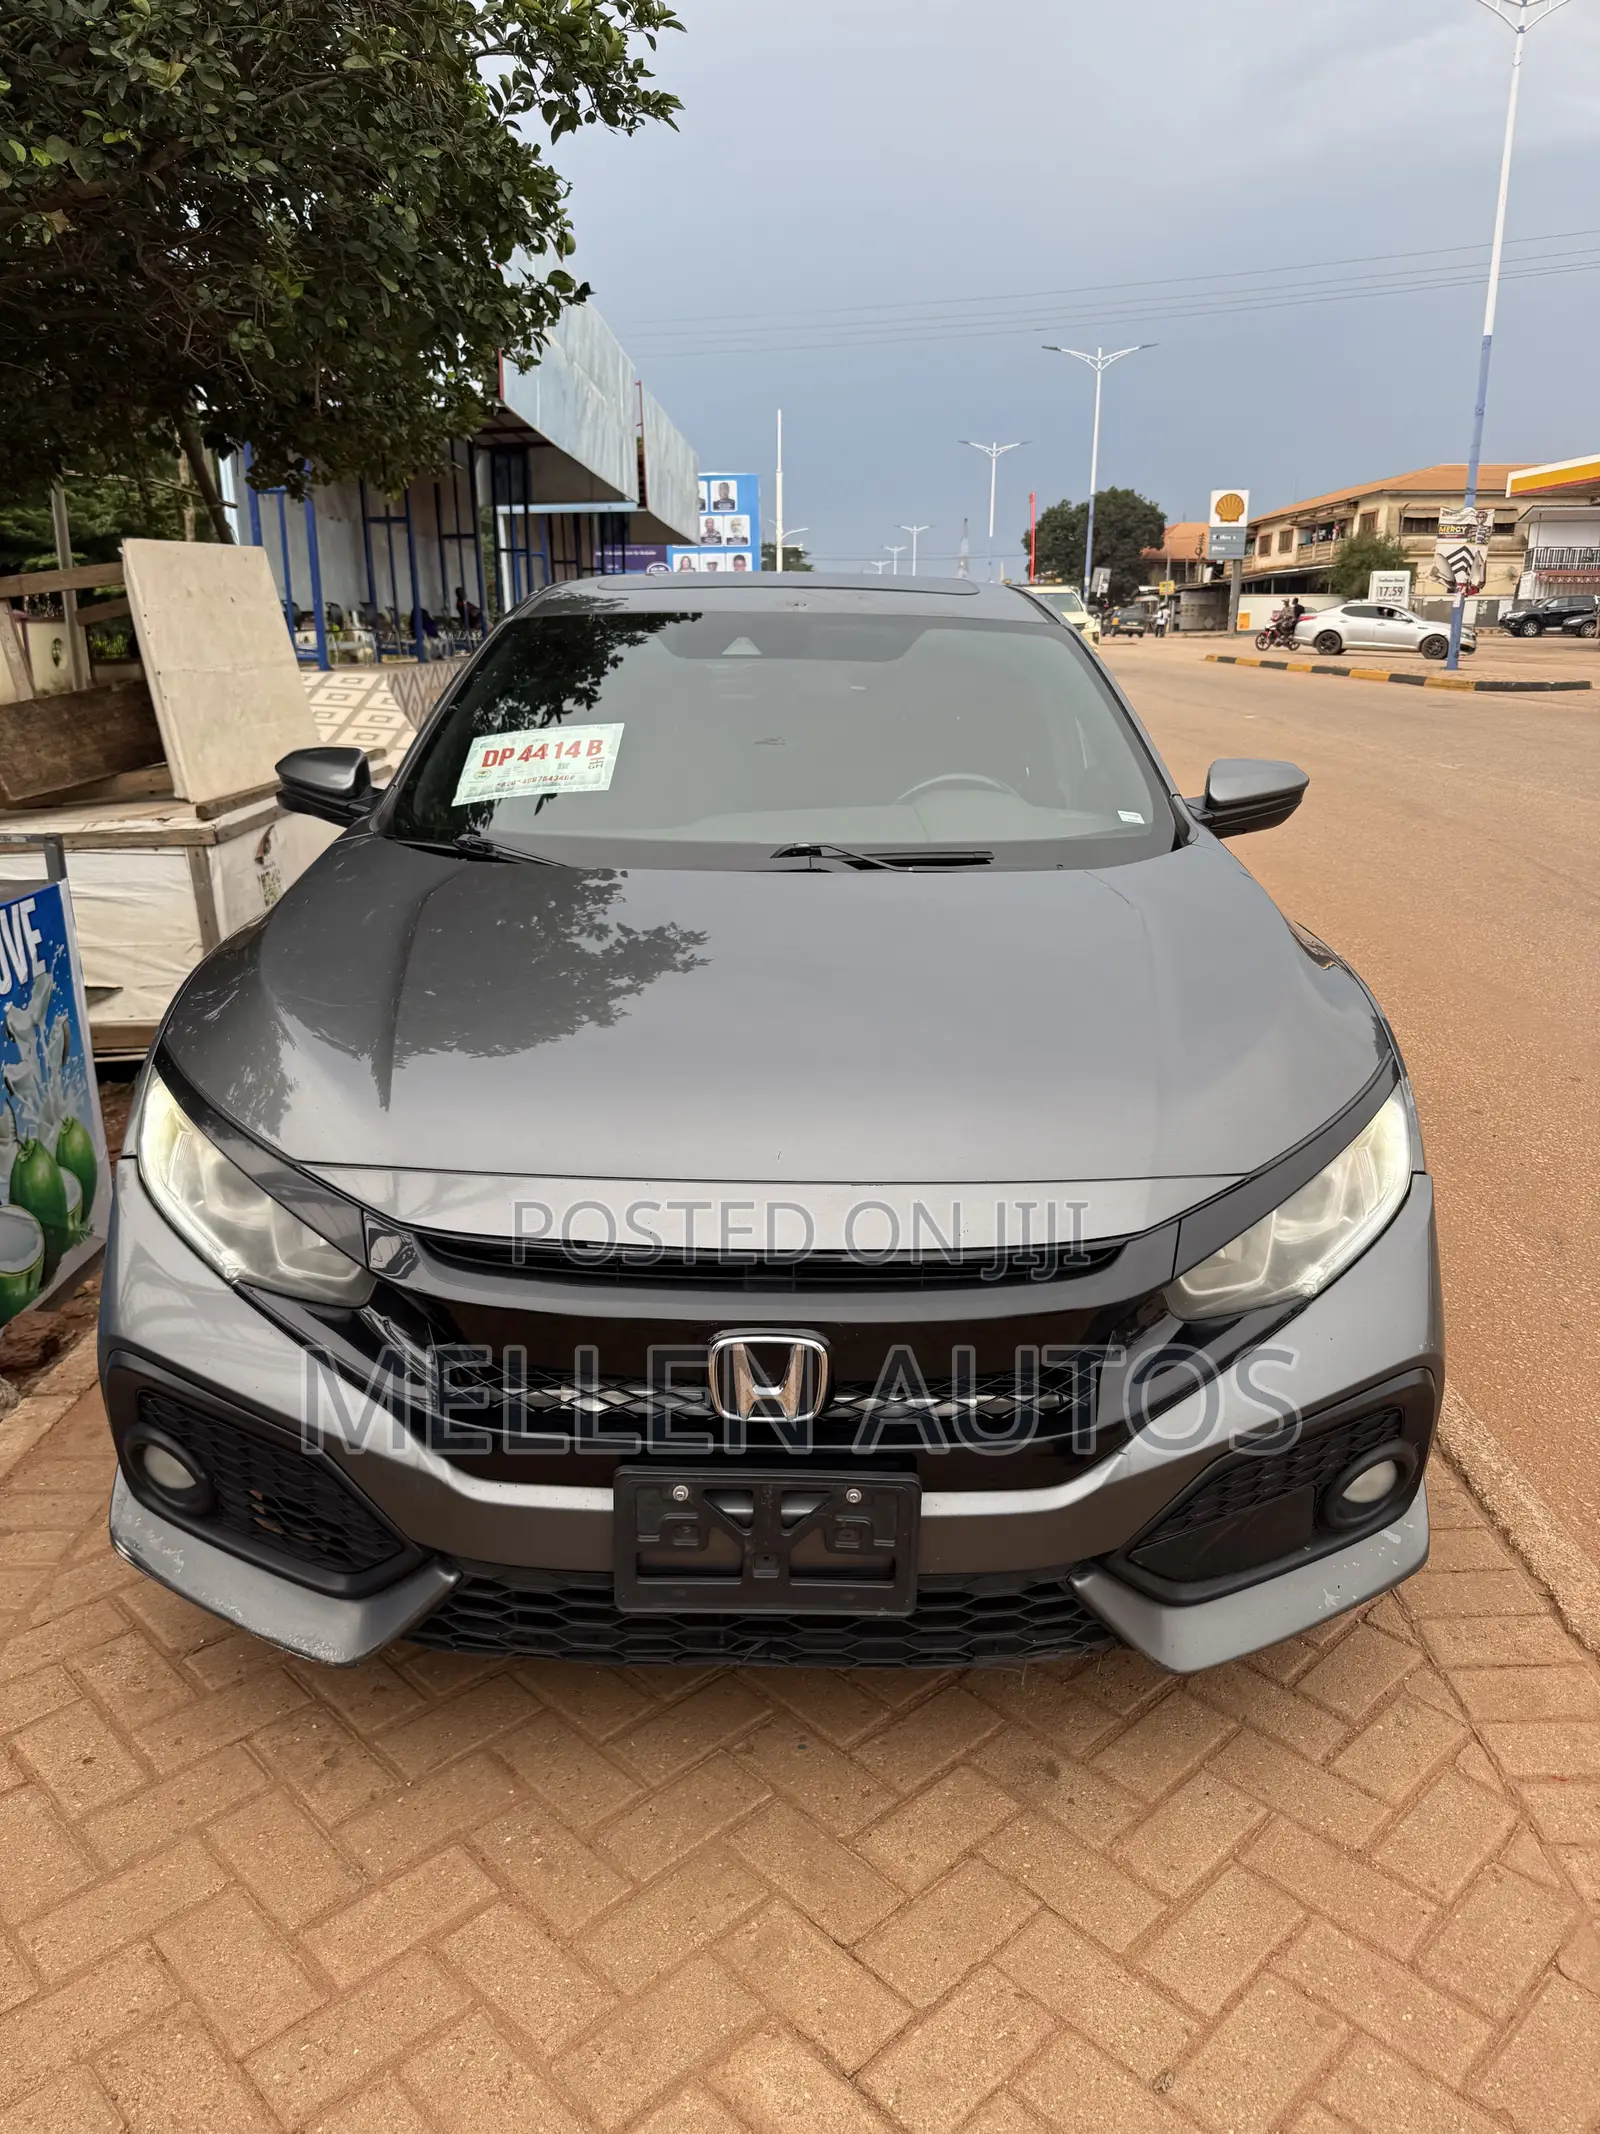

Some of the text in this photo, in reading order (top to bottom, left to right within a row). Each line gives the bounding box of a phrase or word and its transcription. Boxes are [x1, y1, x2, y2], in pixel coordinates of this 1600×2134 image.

[1439, 525, 1468, 534] MERCY
[1379, 586, 1403, 597] 17.59
[481, 747, 515, 768] DP
[586, 739, 604, 757] B
